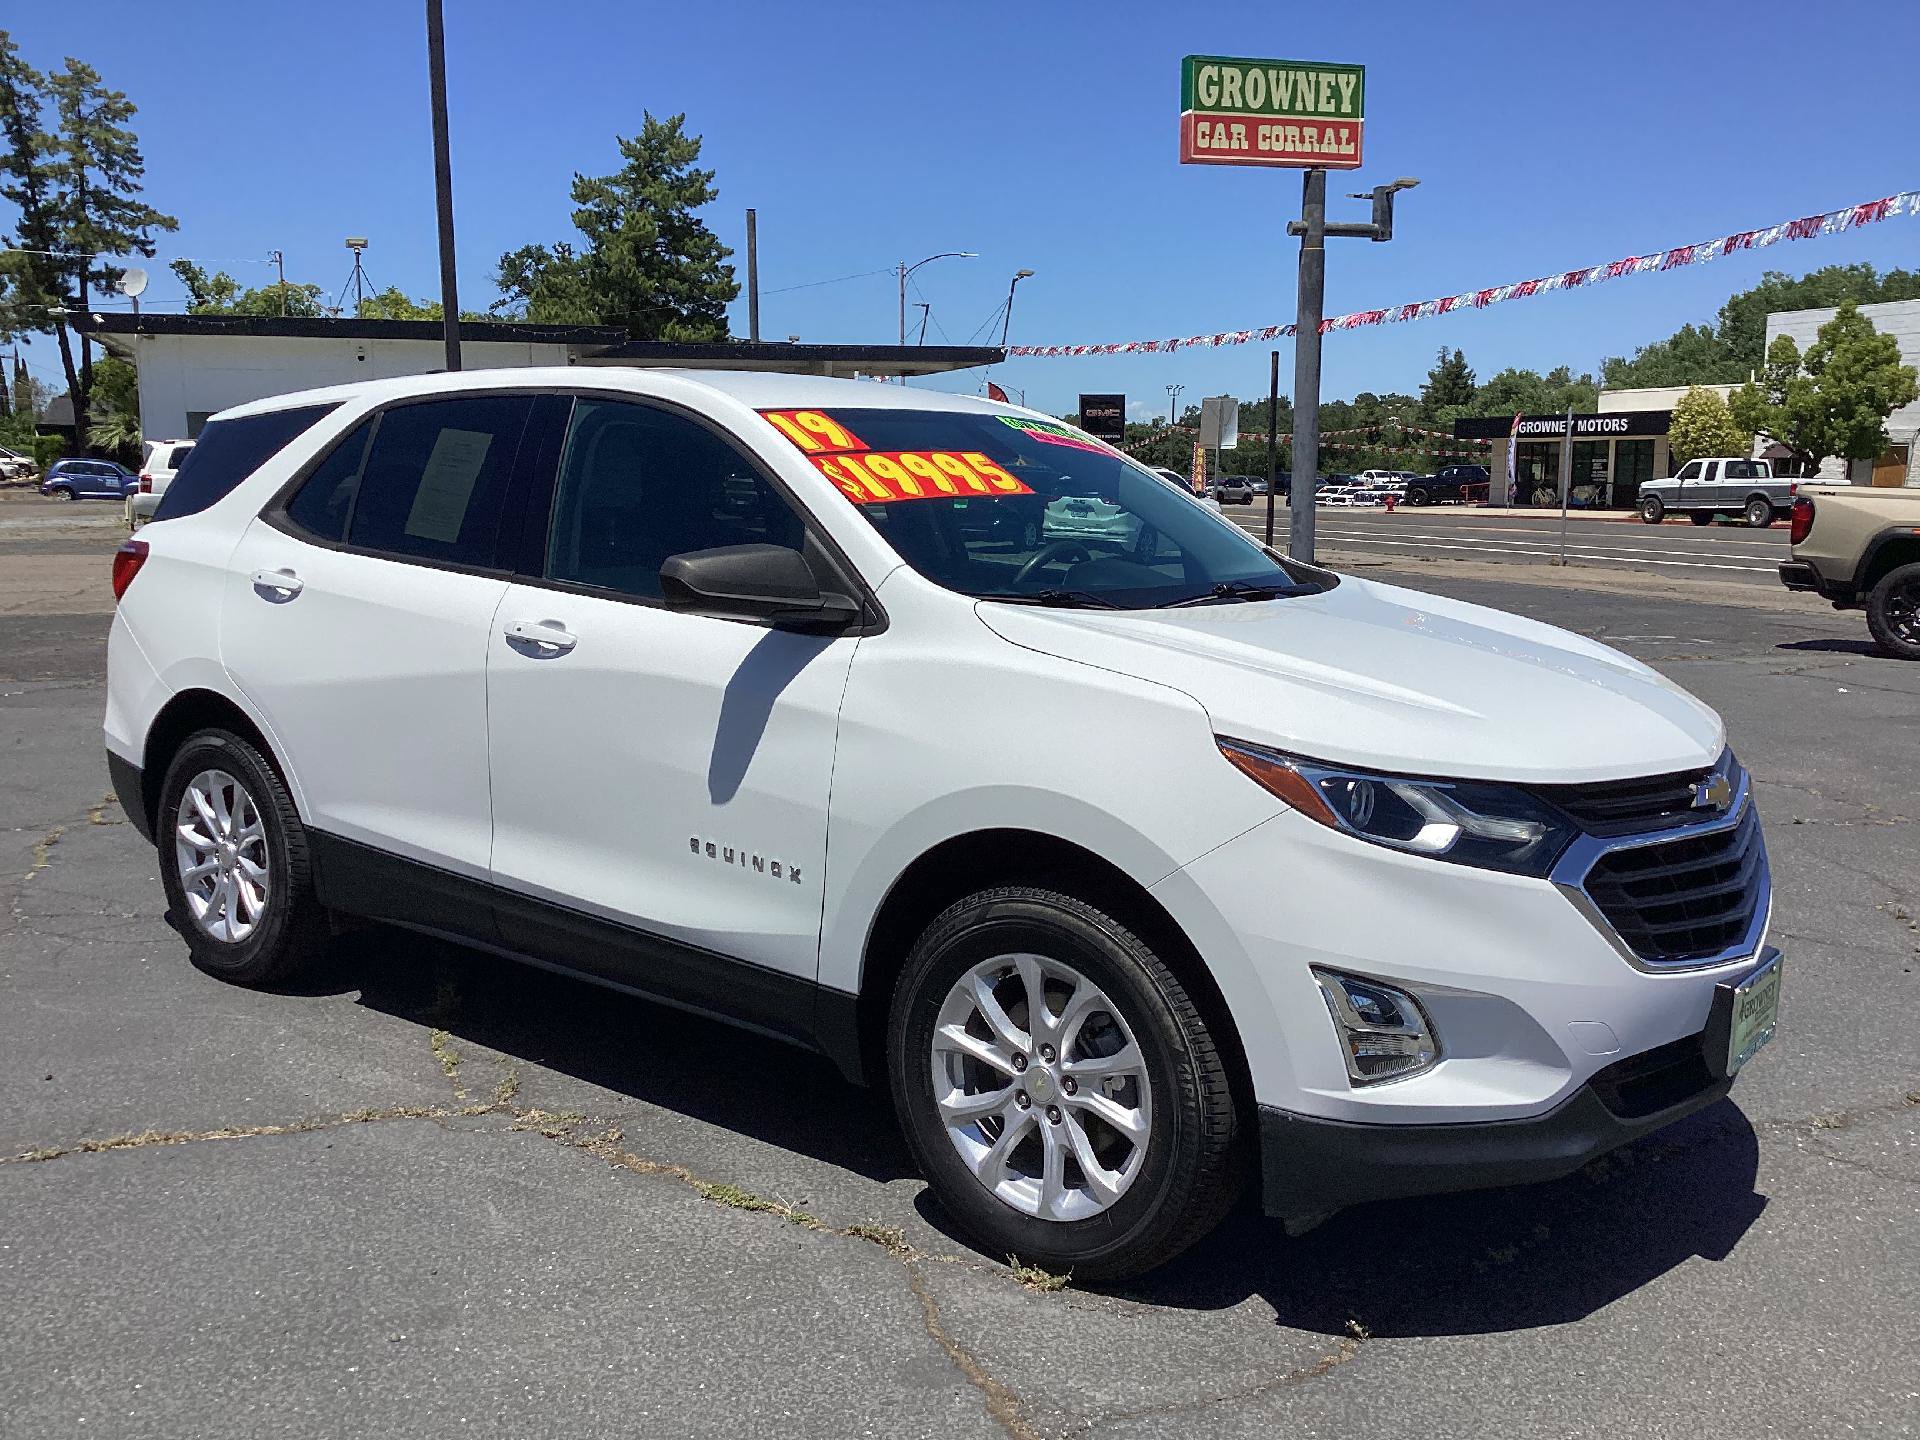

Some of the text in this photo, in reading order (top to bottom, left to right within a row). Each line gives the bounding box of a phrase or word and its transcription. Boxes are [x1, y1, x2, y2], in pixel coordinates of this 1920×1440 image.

[1198, 65, 1357, 112] GROWNEY
[1197, 121, 1355, 155] CAR CORRAL
[767, 411, 855, 450] 19
[1577, 418, 1628, 432] MOTORS
[818, 453, 1020, 500] $19995
[689, 837, 801, 885] EQUINOX
